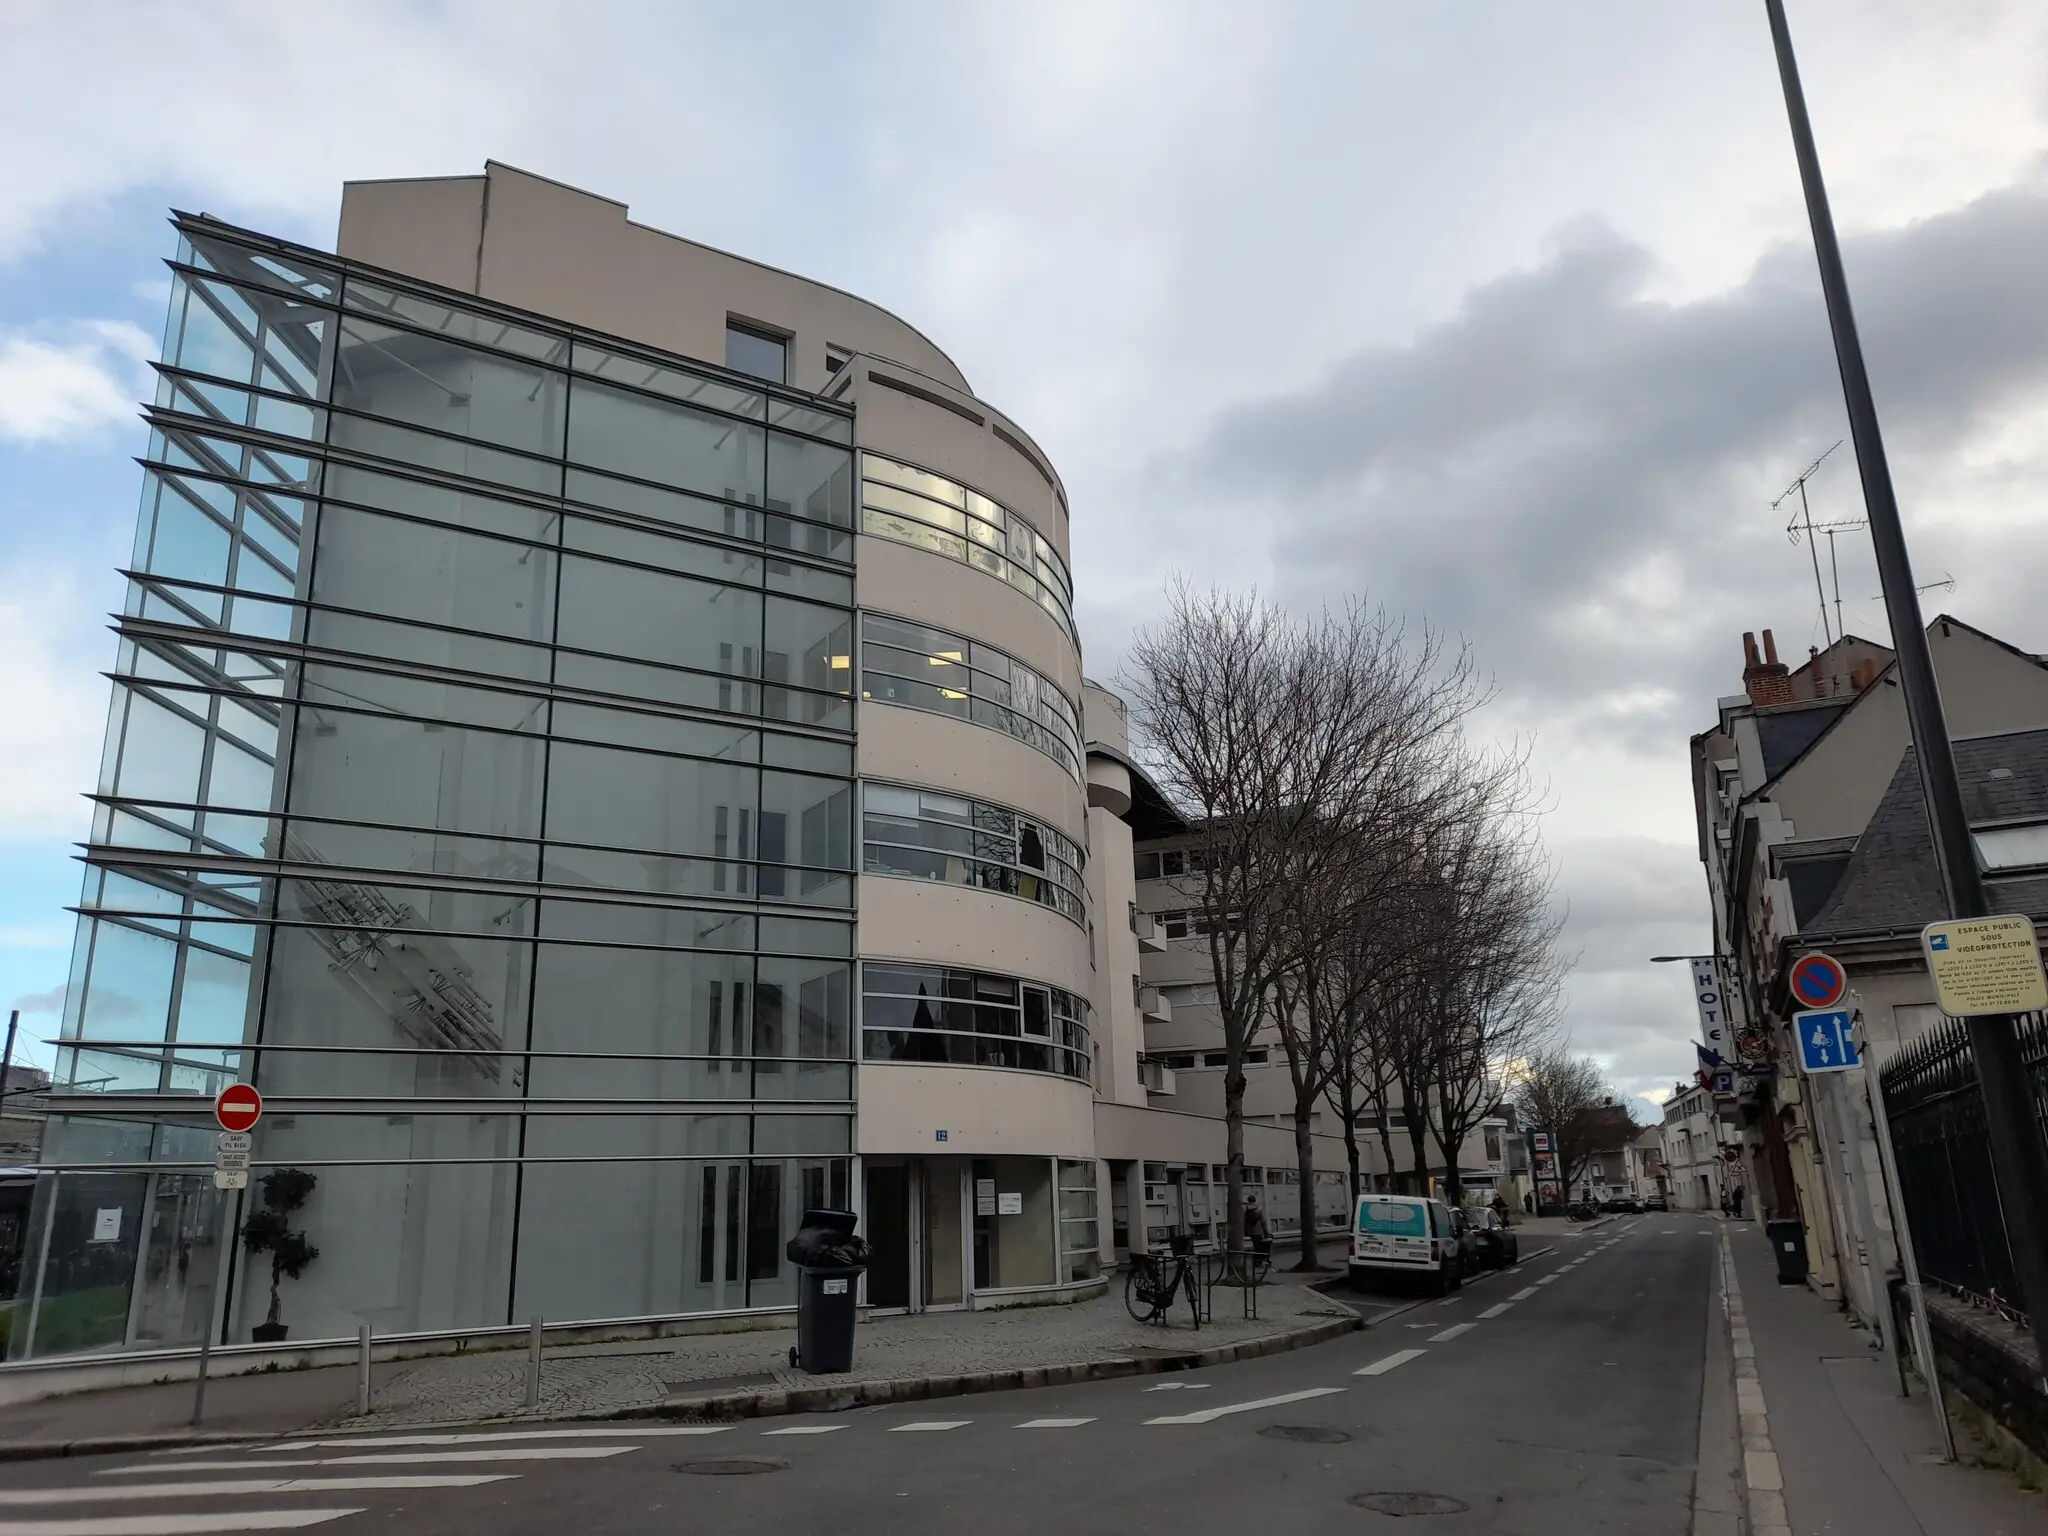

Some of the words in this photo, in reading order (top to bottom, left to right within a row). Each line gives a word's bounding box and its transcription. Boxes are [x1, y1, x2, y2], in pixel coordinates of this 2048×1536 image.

[1957, 925, 1989, 934] ESPACE
[1993, 922, 2021, 931] PUBLIC
[1980, 933, 2003, 942] SOUS
[1957, 940, 2032, 953] VIDÉOPROTECTION
[1698, 974, 1724, 1059] HOTEL
[1717, 1075, 1729, 1090] P
[937, 1131, 946, 1140] 12
